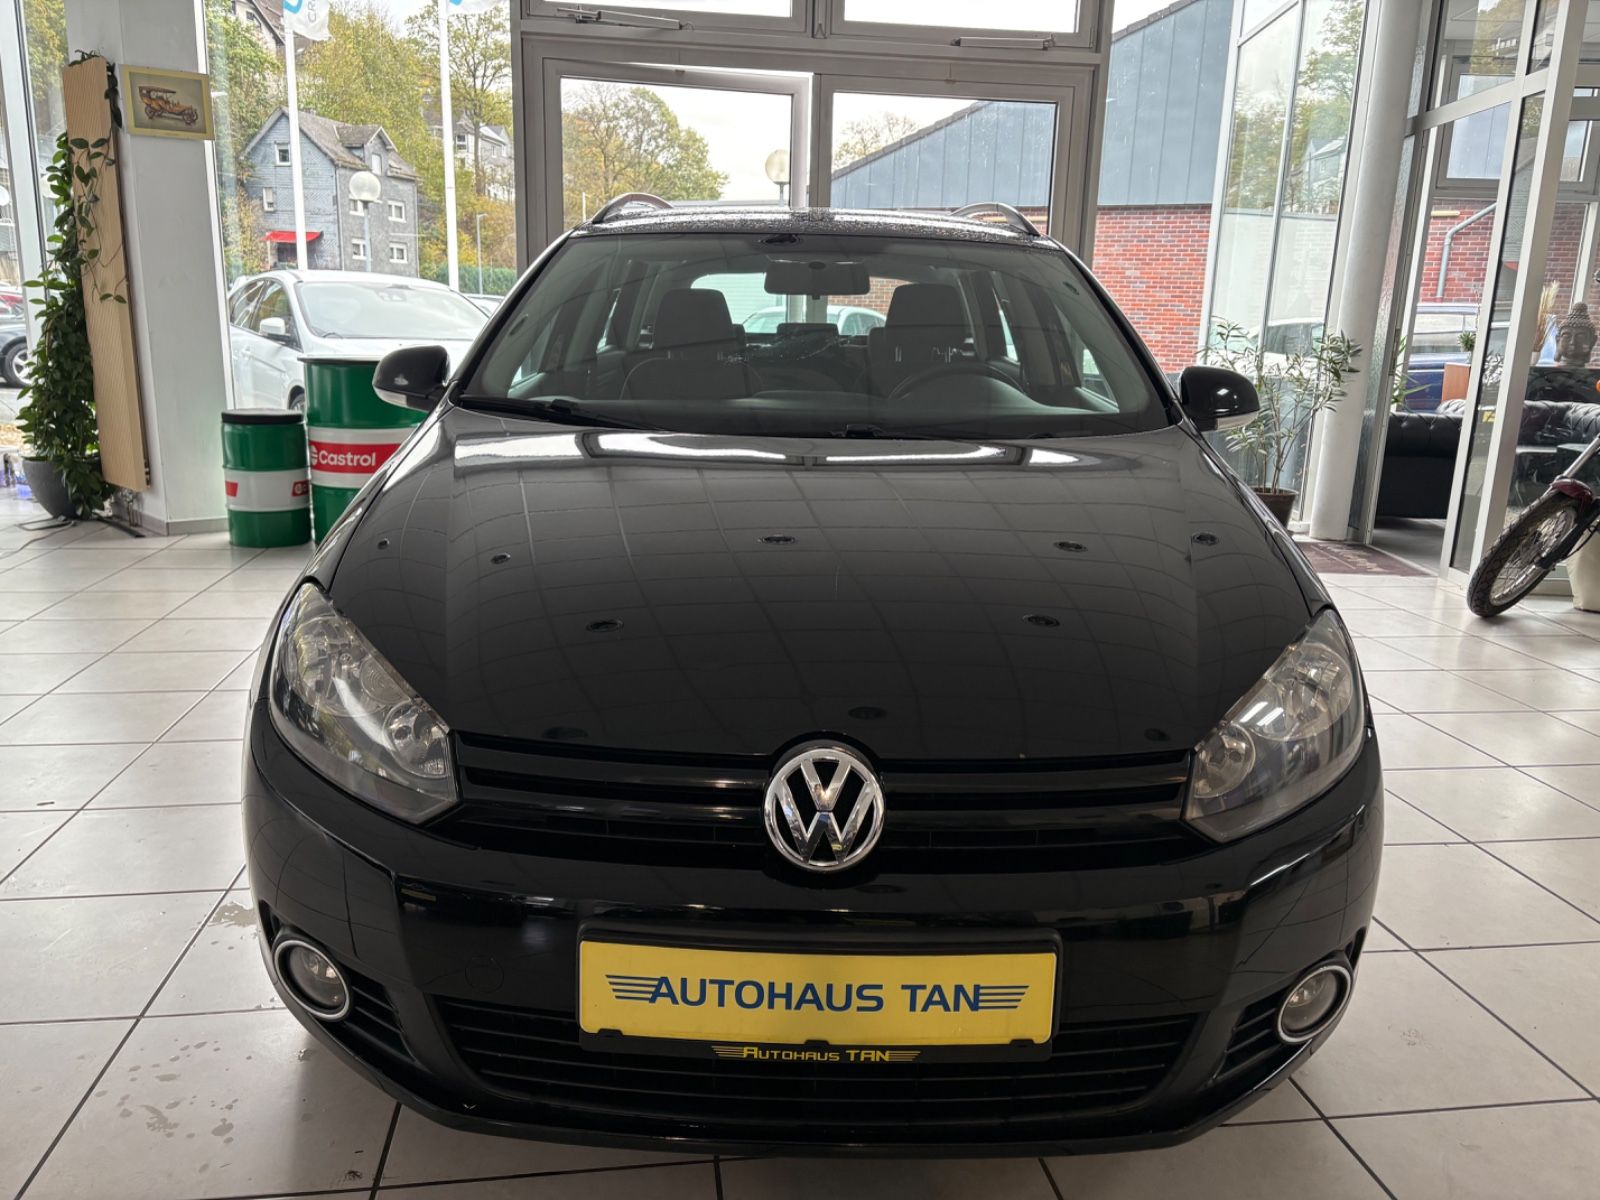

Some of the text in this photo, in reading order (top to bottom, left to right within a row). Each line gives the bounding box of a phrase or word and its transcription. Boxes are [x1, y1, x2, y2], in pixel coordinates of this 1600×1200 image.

[319, 450, 376, 466] Castrol
[649, 976, 980, 1012] AUTOHAUS TAN
[845, 1050, 890, 1063] TAN
